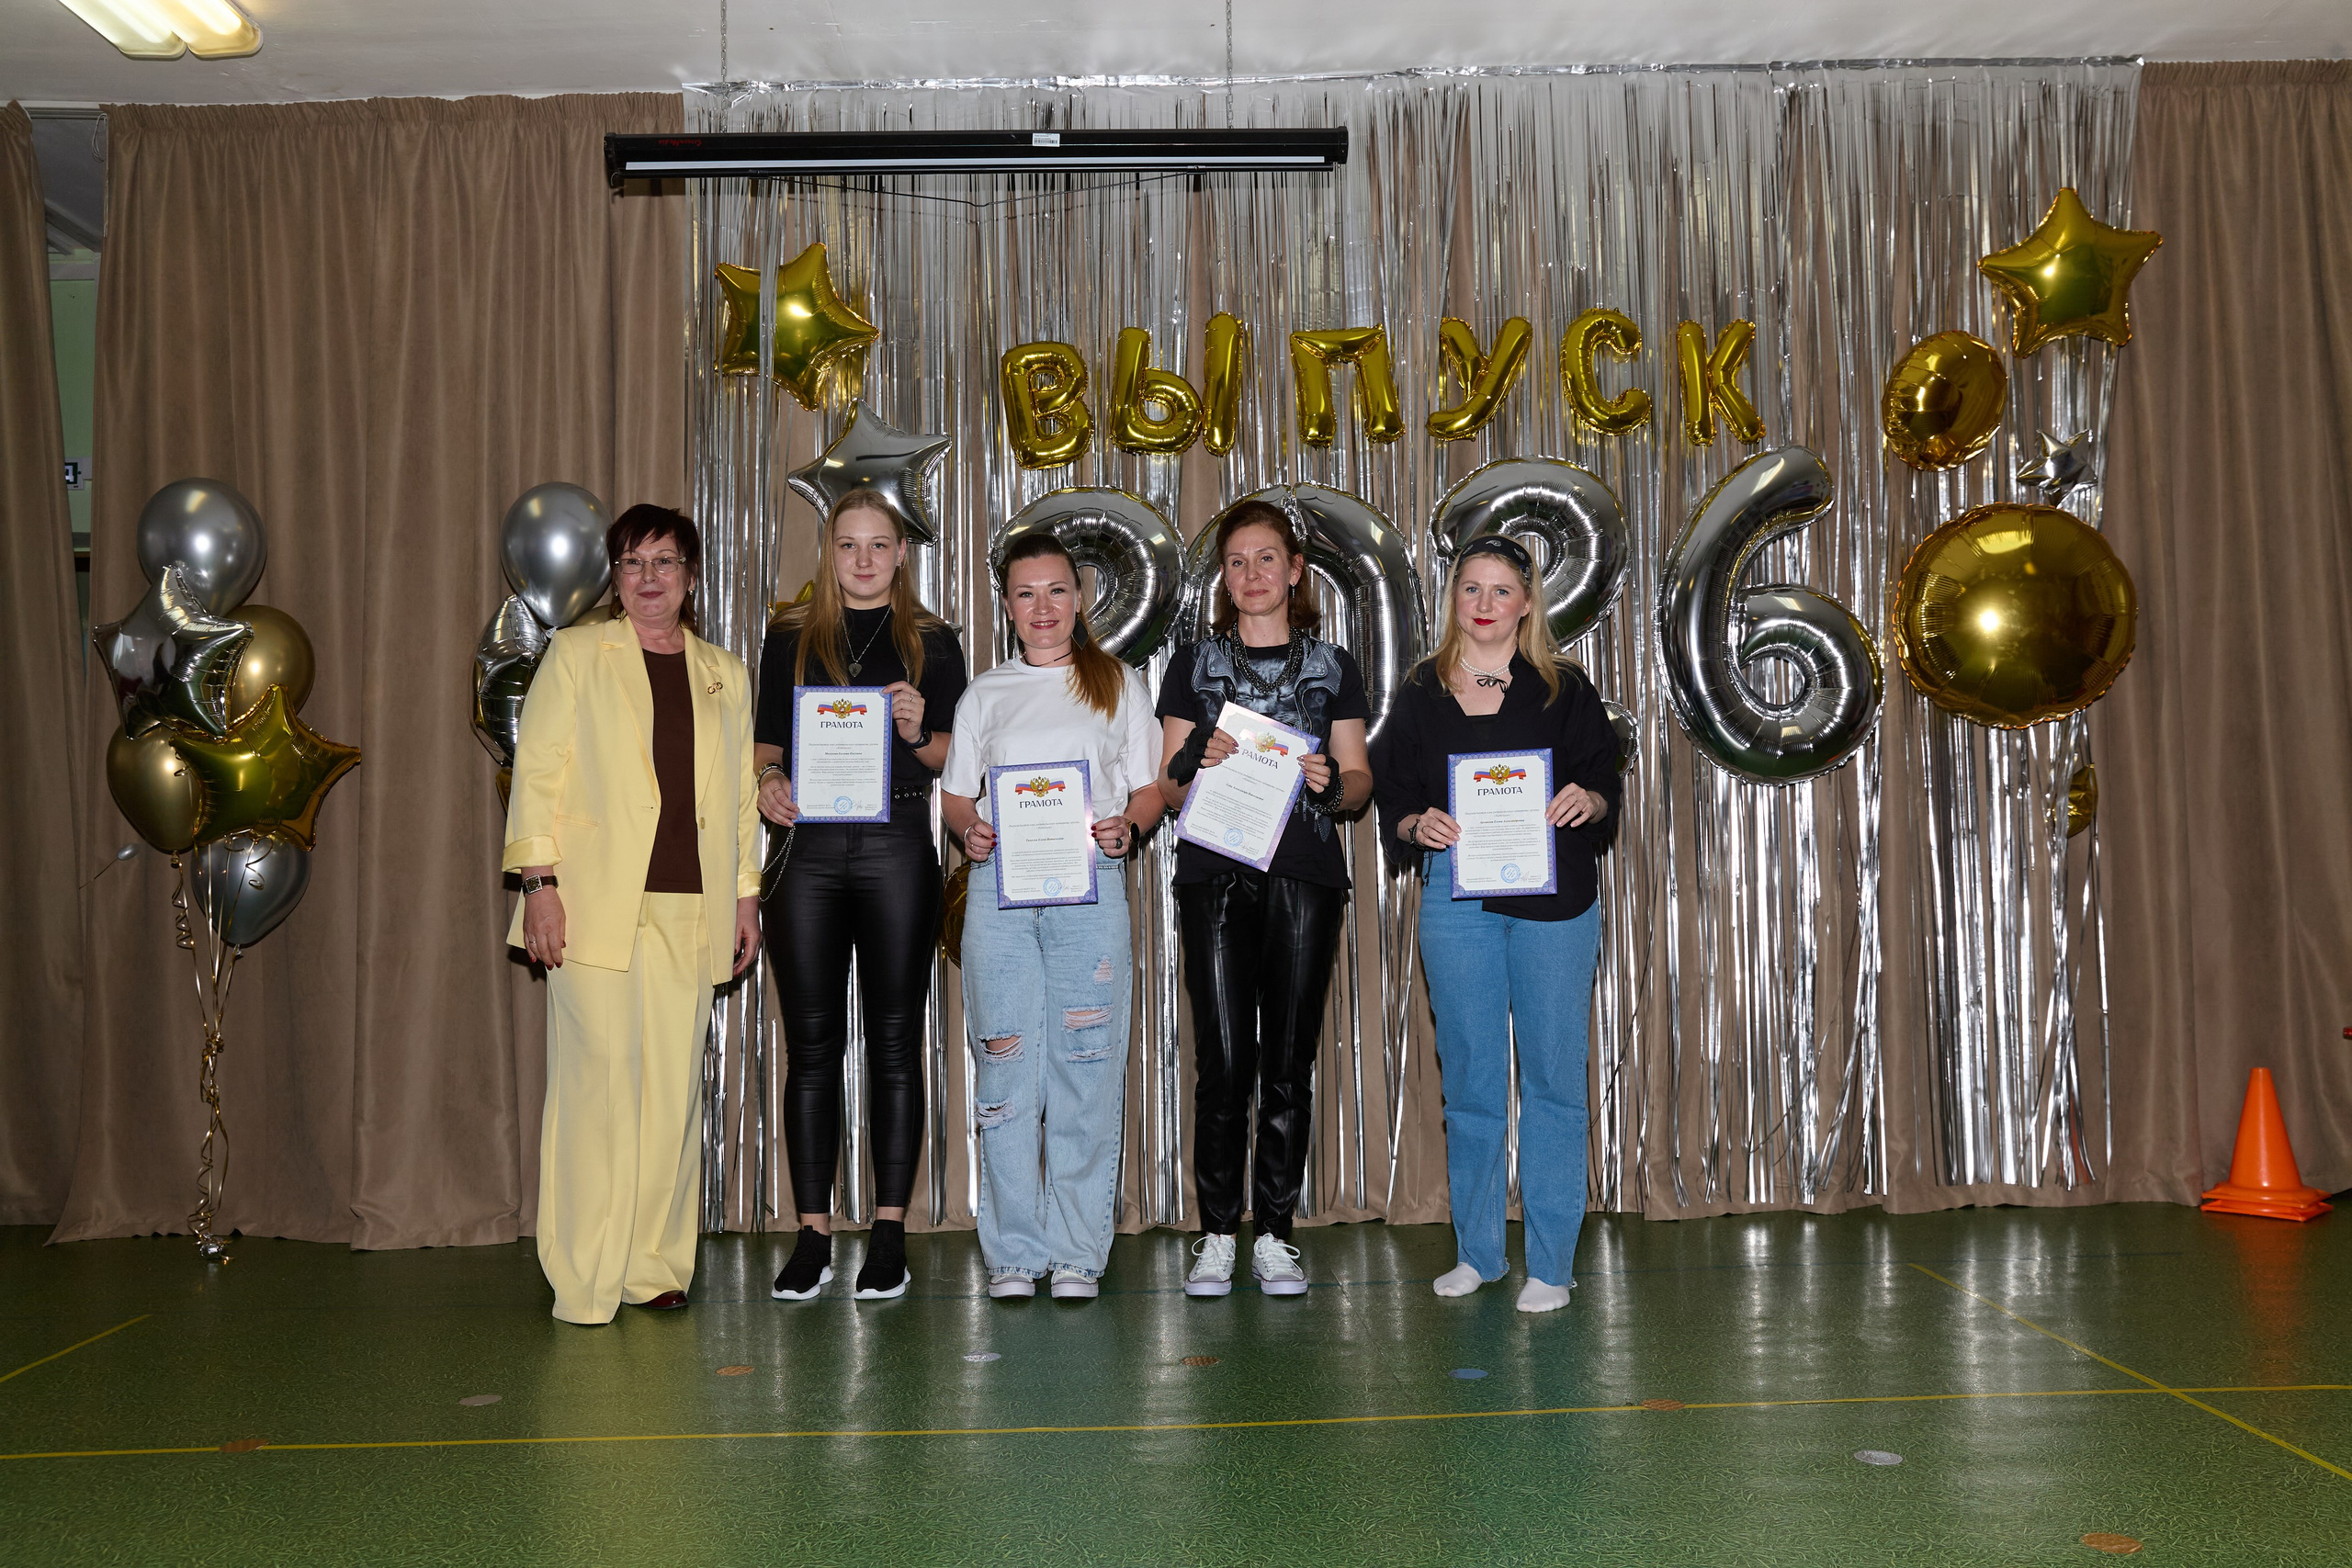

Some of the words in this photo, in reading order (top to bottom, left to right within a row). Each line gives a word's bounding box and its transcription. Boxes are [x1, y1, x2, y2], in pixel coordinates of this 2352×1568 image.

[1001, 307, 1767, 470] ВЫПУСК
[1238, 746, 1279, 770] РАМОТА
[1477, 786, 1523, 796] ГРАМОТА
[1019, 798, 1063, 809] ГРАМОТА
